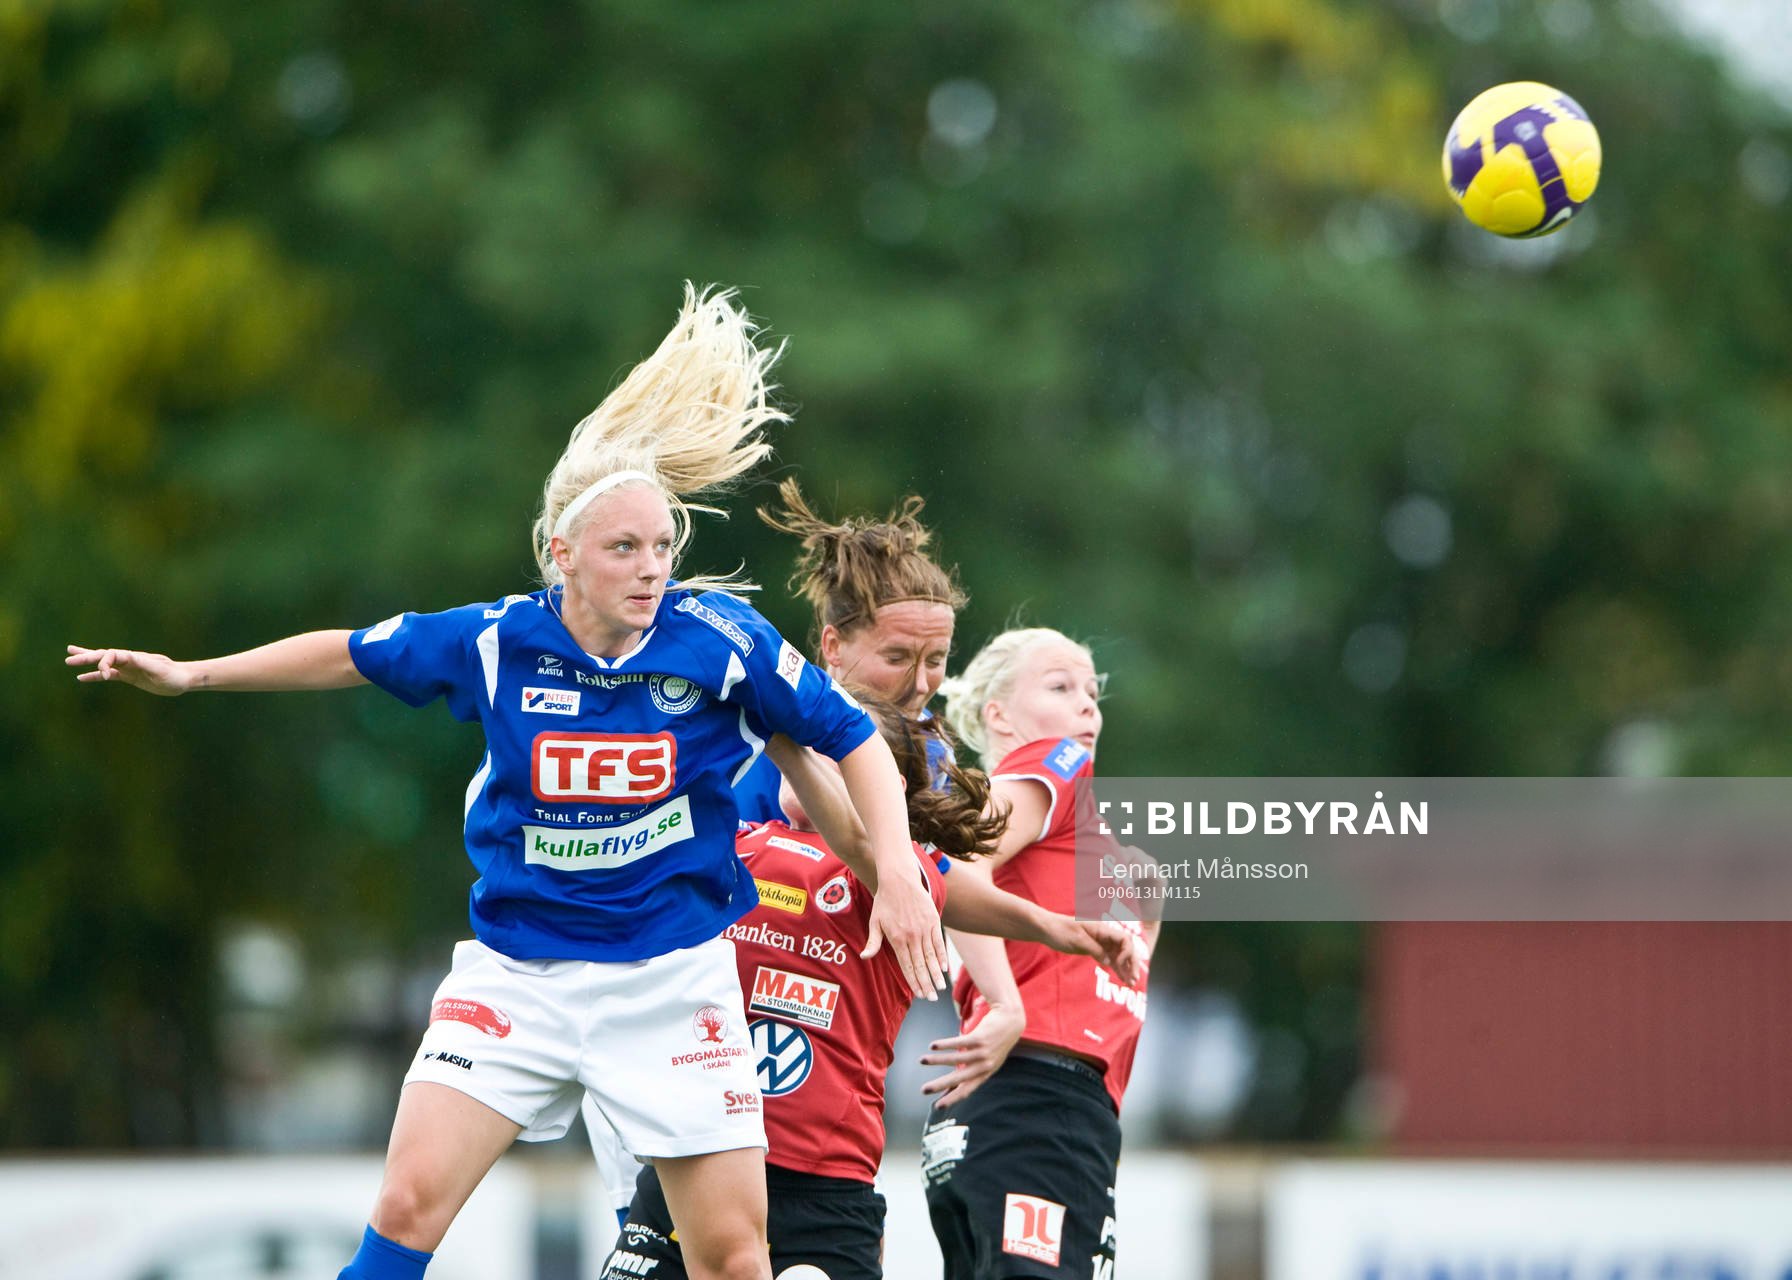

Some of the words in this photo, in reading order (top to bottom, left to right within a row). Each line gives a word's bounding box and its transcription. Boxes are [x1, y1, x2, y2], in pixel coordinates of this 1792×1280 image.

[782, 647, 800, 683] Sca
[575, 669, 644, 690] Folksam
[544, 692, 574, 703] INTER
[544, 702, 573, 712] SPORT
[546, 747, 666, 791] TFS
[535, 809, 571, 823] TRIAL
[577, 812, 614, 823] FORM
[534, 811, 682, 858] kullaflyg.se
[757, 885, 803, 907] tektkopia
[720, 922, 795, 953] banken
[801, 934, 847, 965] 1826
[755, 969, 838, 1011] MAXI
[753, 995, 766, 1004] ICA
[767, 998, 831, 1019] STORMARKNAD
[436, 1052, 473, 1070] MASITA
